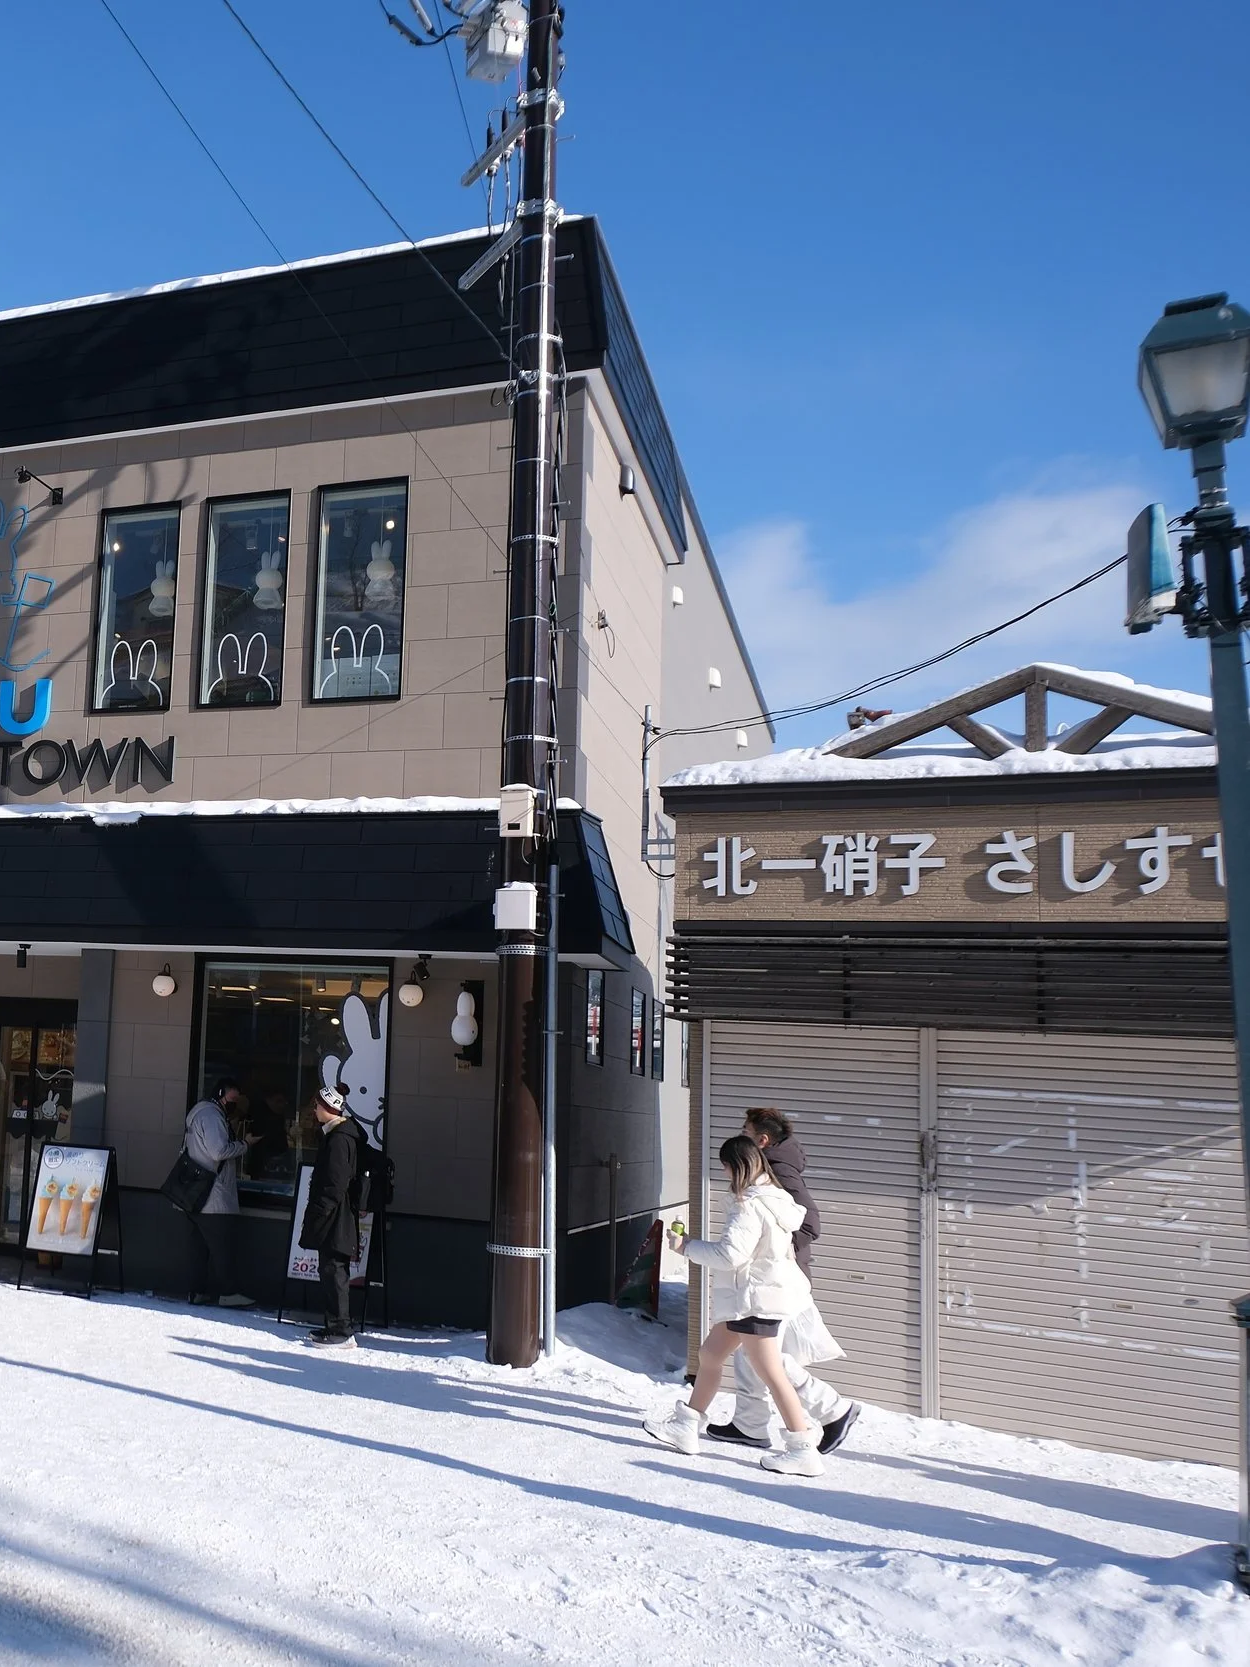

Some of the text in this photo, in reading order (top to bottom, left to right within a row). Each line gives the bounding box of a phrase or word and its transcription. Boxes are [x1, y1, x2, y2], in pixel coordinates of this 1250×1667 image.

[702, 832, 947, 897] 北一硝子
[292, 1262, 319, 1273] 202
